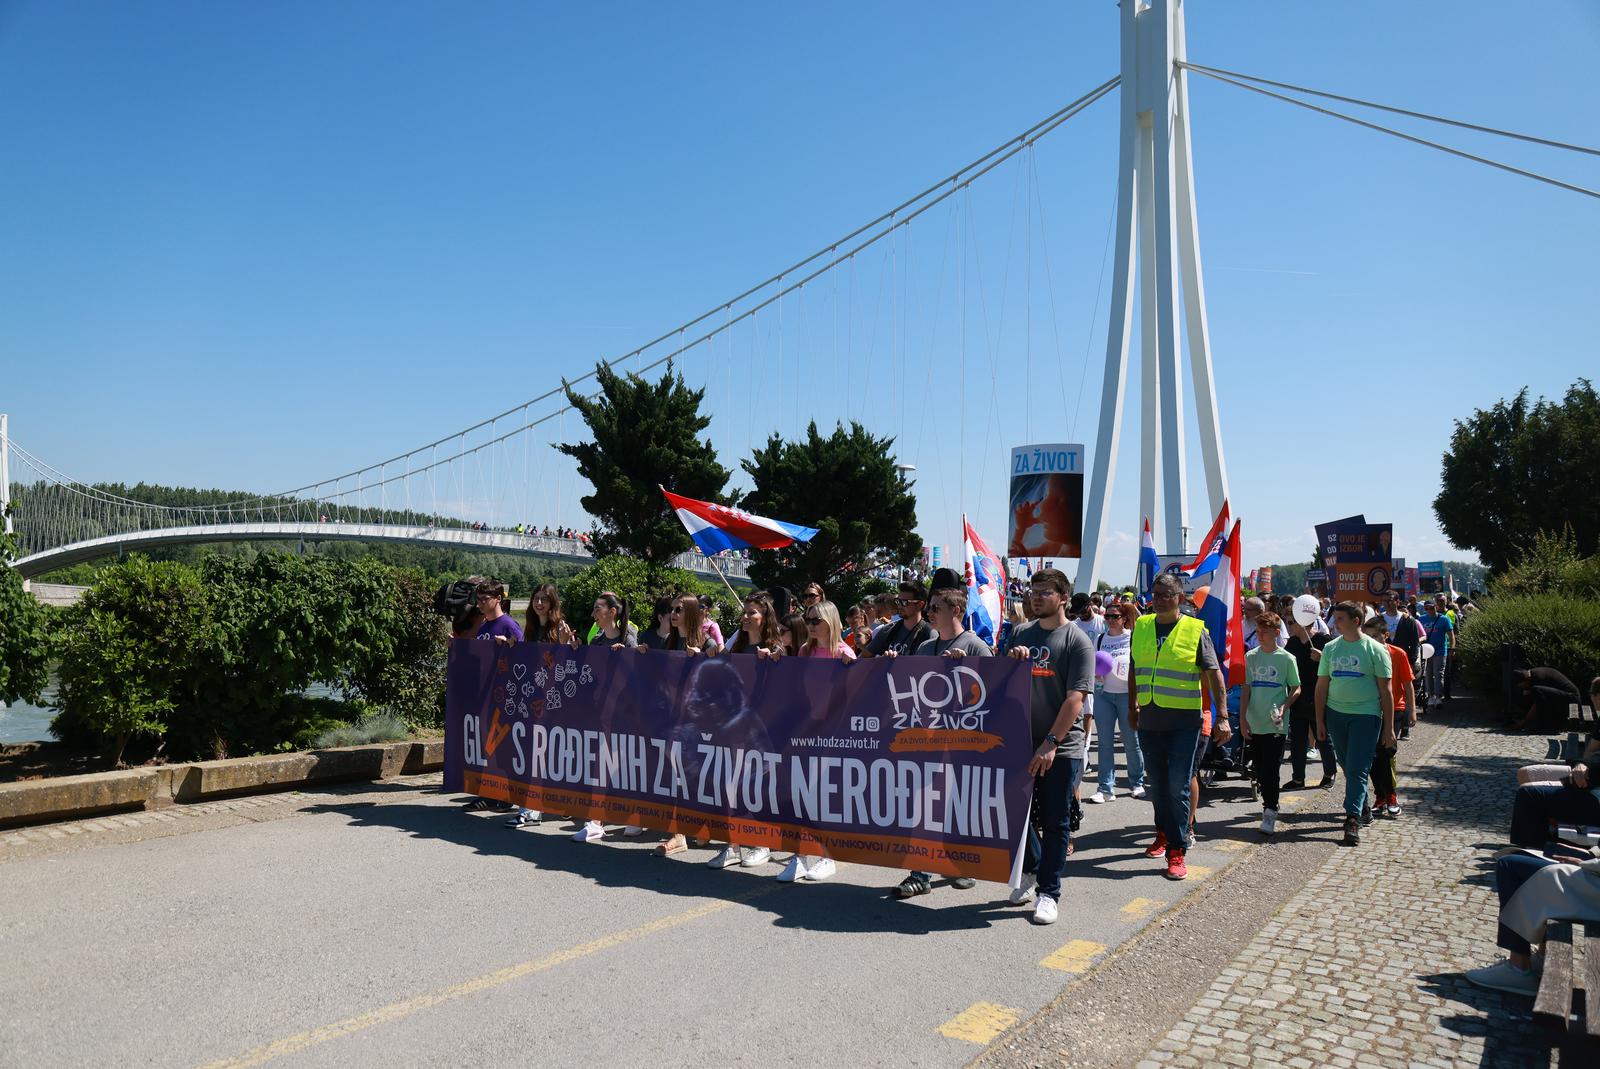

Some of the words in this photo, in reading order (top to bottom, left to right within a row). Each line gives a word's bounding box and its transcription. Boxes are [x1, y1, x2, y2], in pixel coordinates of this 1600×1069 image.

[1014, 453, 1030, 474] ZA
[1033, 448, 1077, 472] ŽIVOT
[1339, 573, 1355, 581] OVO
[1356, 572, 1365, 581] JE
[1339, 582, 1365, 591] DIJETE
[1029, 646, 1051, 662] OD
[1331, 655, 1360, 666] HOD
[1249, 665, 1279, 677] HOD
[887, 665, 987, 714] HOD
[892, 706, 924, 730] ZA
[928, 709, 990, 732] ŽIVOT
[790, 735, 880, 750] www.hodzazivot.hr
[463, 707, 526, 776] GLAS
[531, 724, 648, 793] ROĐENIH
[651, 738, 690, 801] ZA
[696, 732, 783, 815] ŽIVOT
[791, 755, 1009, 840] NEROĐENIH
[579, 797, 607, 809] RIJEKA
[612, 802, 630, 813] SINJ
[636, 805, 660, 818] SISAK
[711, 819, 736, 831] BROD
[742, 825, 768, 836] SPLIT
[775, 827, 824, 844] VARAŽDIN
[830, 837, 883, 852] VINKOVCI
[892, 843, 928, 858] ZADAR
[937, 849, 981, 864] ZAGREB
